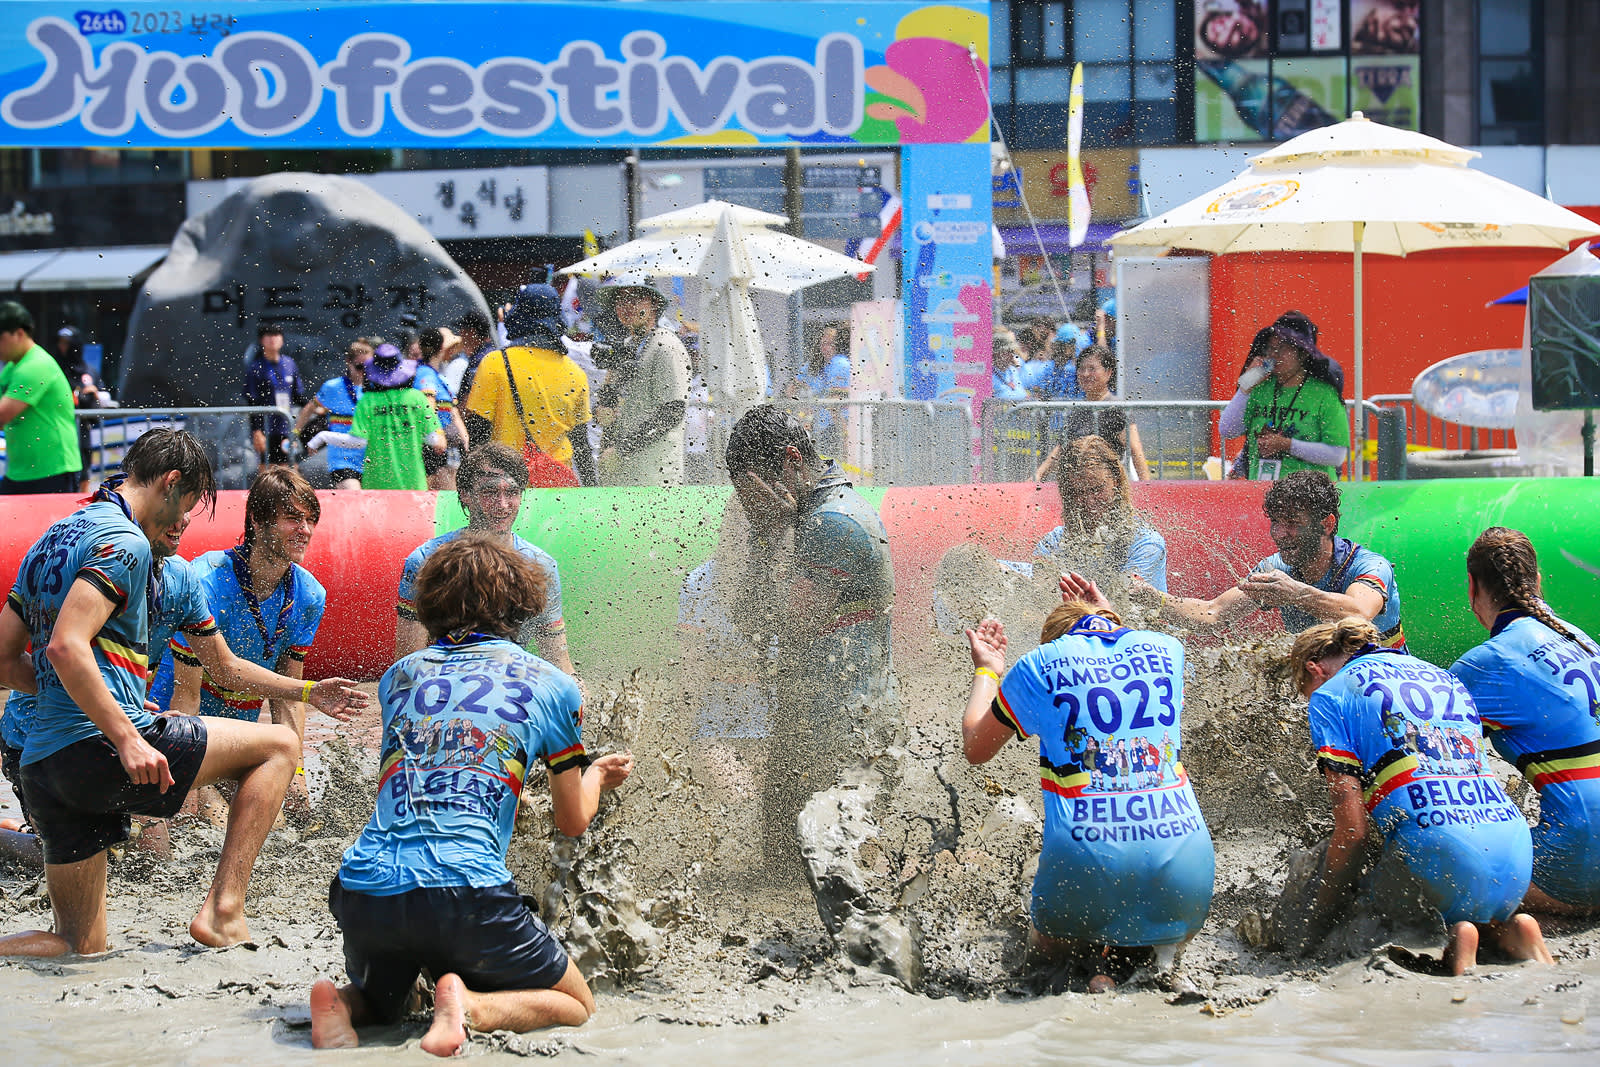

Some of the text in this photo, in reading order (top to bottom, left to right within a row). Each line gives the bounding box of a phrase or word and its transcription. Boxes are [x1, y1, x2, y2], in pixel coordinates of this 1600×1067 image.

[81, 11, 234, 38] 26th 2023 보령
[1072, 653, 1124, 667] WORLD
[1125, 643, 1169, 657] SCOUT
[1046, 654, 1174, 694] JAMBOREE
[1356, 667, 1462, 687] JAMBOR
[387, 674, 534, 728] 2023
[1053, 677, 1176, 742] 2023
[1363, 682, 1481, 728] 2023
[390, 770, 506, 807] BLGIAN
[1073, 790, 1193, 822] BELGIAN
[1071, 815, 1201, 842] CONTINGENT
